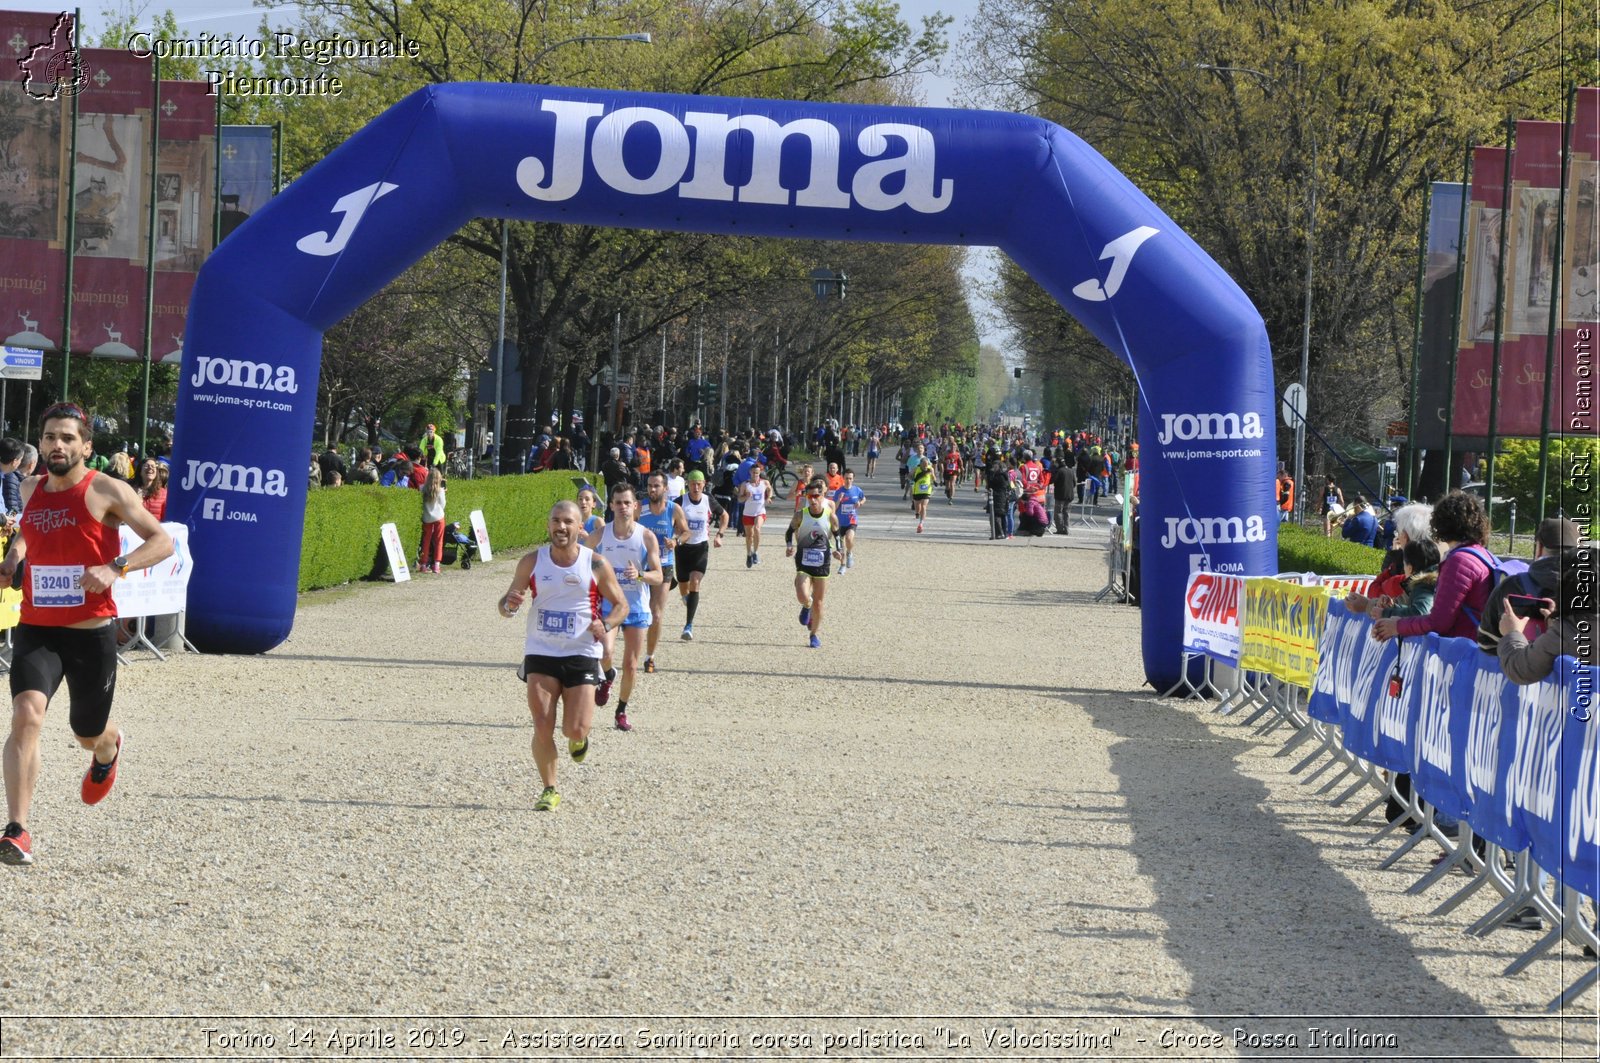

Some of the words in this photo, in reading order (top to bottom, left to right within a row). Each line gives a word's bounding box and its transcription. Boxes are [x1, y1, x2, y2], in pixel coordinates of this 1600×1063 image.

[516, 98, 954, 214] Joma
[191, 356, 298, 395] Joma
[193, 393, 292, 413] www.joma-sport.com
[1158, 411, 1264, 445] Joma
[1162, 448, 1261, 461] www.joma-sport.com
[181, 459, 288, 497] Joma
[226, 511, 258, 523] JOMA
[1161, 514, 1267, 549] Joma
[1214, 562, 1244, 573] JOMA
[41, 575, 71, 590] 3240
[1187, 574, 1243, 627] GIMA
[546, 616, 563, 628] 451
